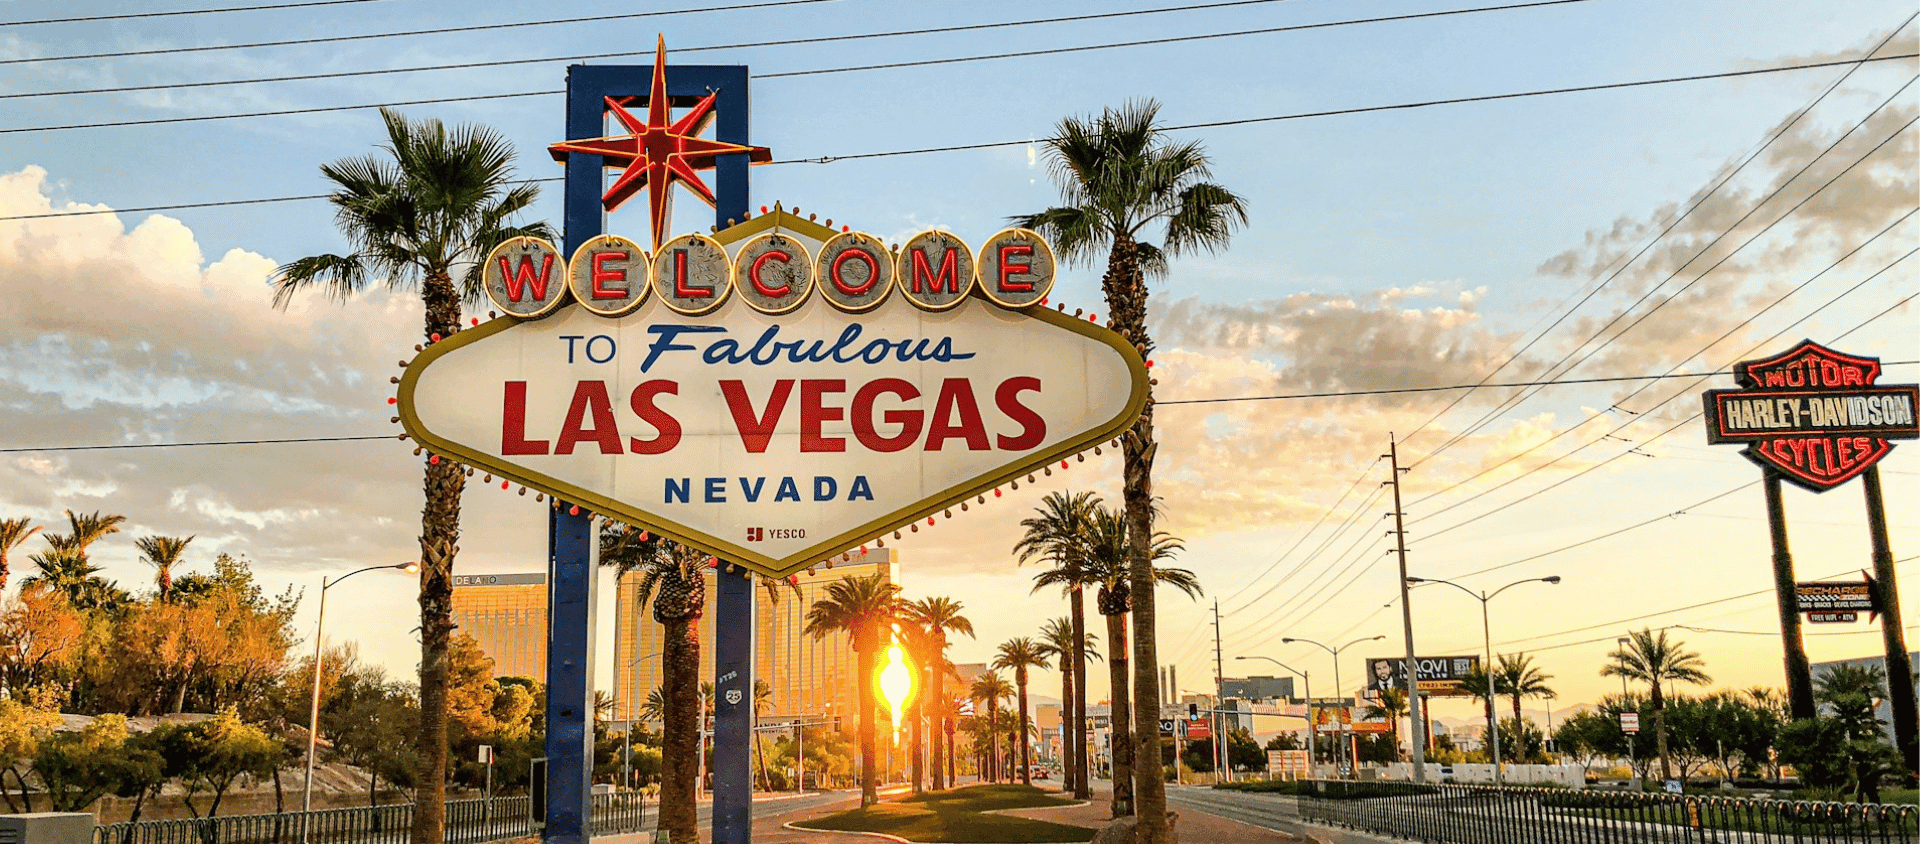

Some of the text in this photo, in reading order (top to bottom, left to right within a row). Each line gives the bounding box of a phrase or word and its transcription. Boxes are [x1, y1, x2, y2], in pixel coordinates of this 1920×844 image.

[499, 245, 1034, 303] WELCOME
[559, 324, 976, 374] TO Fabulous
[1766, 355, 1863, 387] MOTOR
[502, 377, 1047, 456] LAS VEGAS
[1727, 395, 1912, 429] HARLEY-DAVIDSON
[1773, 437, 1873, 476] CYCLES
[664, 476, 874, 504] NEVADA
[769, 528, 806, 539] YESCO
[456, 576, 497, 585] DELANO
